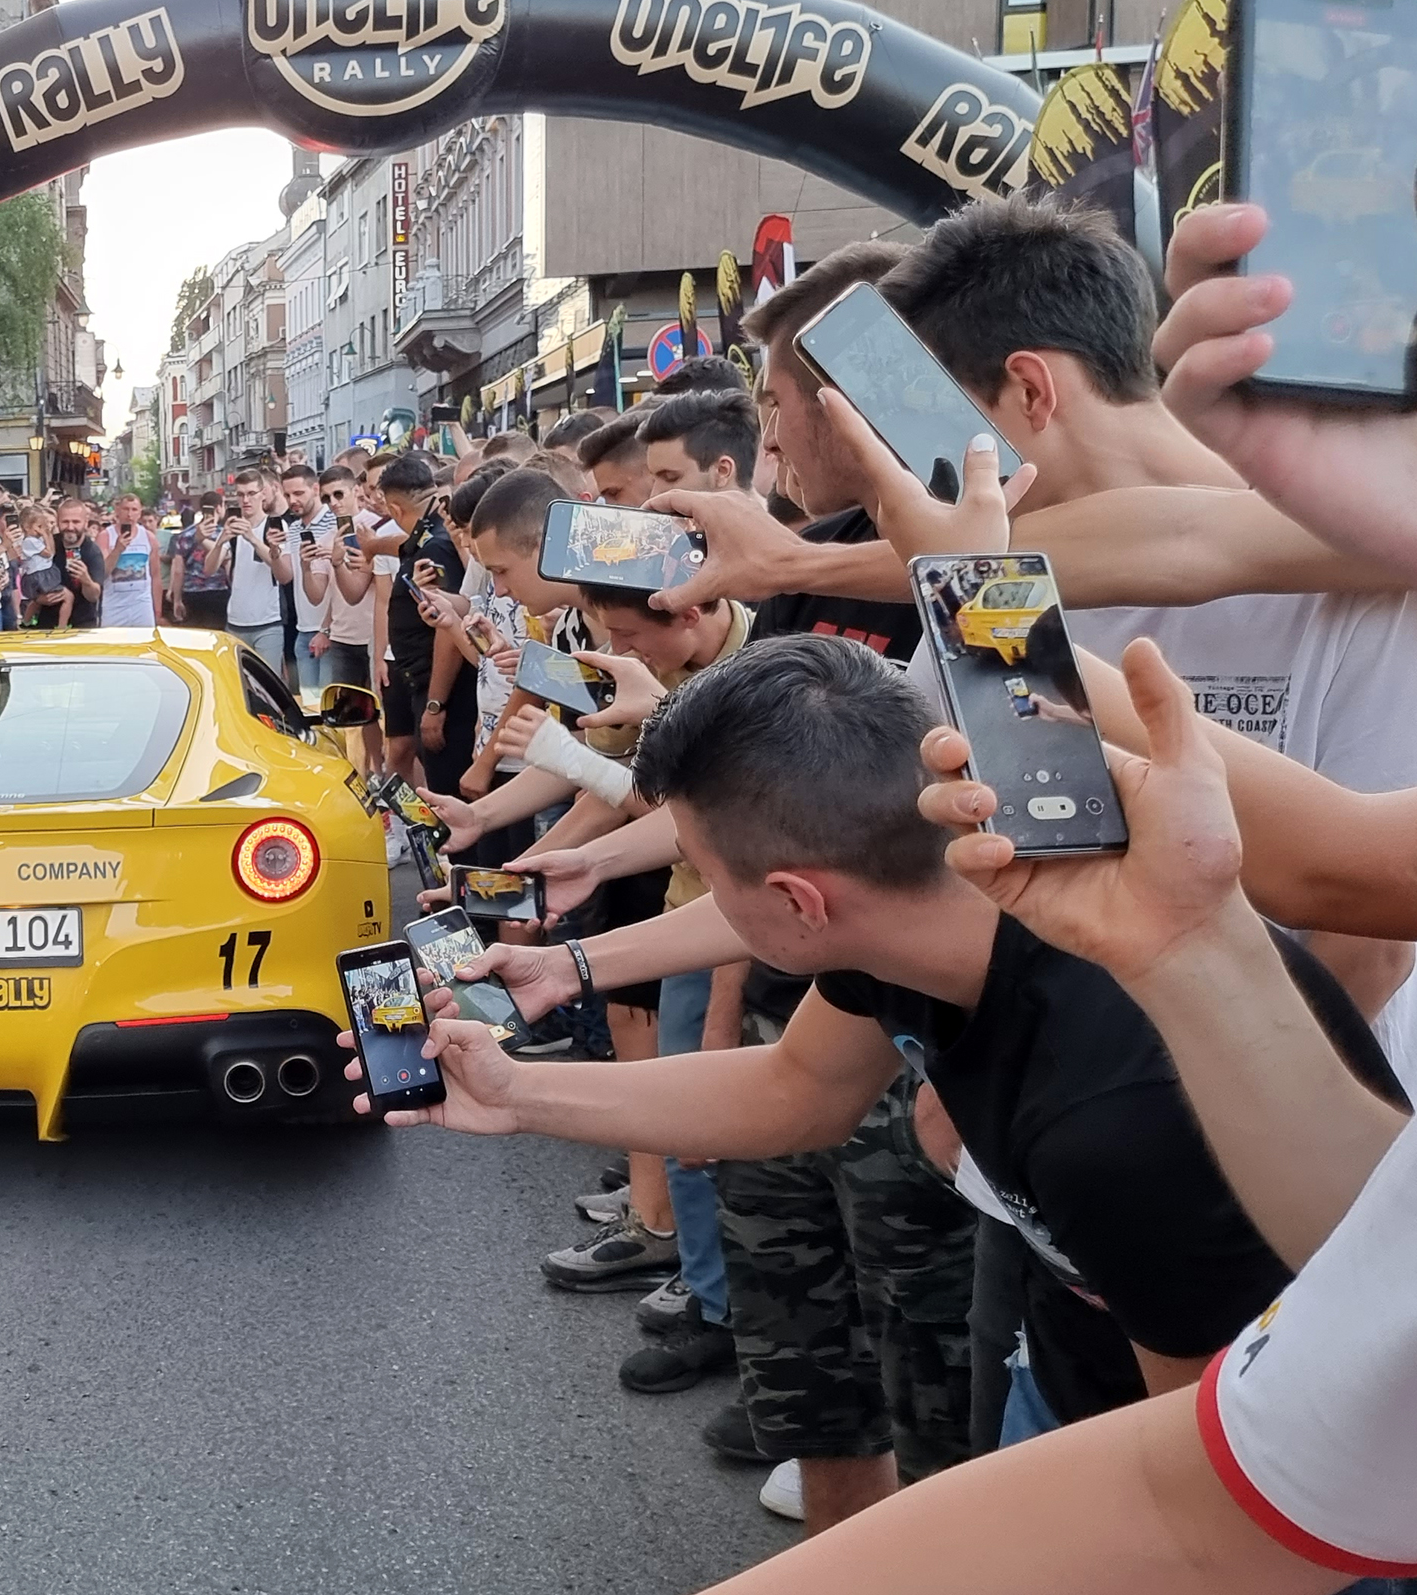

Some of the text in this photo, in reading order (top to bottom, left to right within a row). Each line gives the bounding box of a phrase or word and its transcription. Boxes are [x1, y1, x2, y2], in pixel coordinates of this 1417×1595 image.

[313, 54, 442, 83] RALLY
[394, 164, 407, 234] HOTEL
[394, 252, 407, 317] EURO
[17, 861, 121, 881] COMPANY
[219, 931, 272, 990] 17
